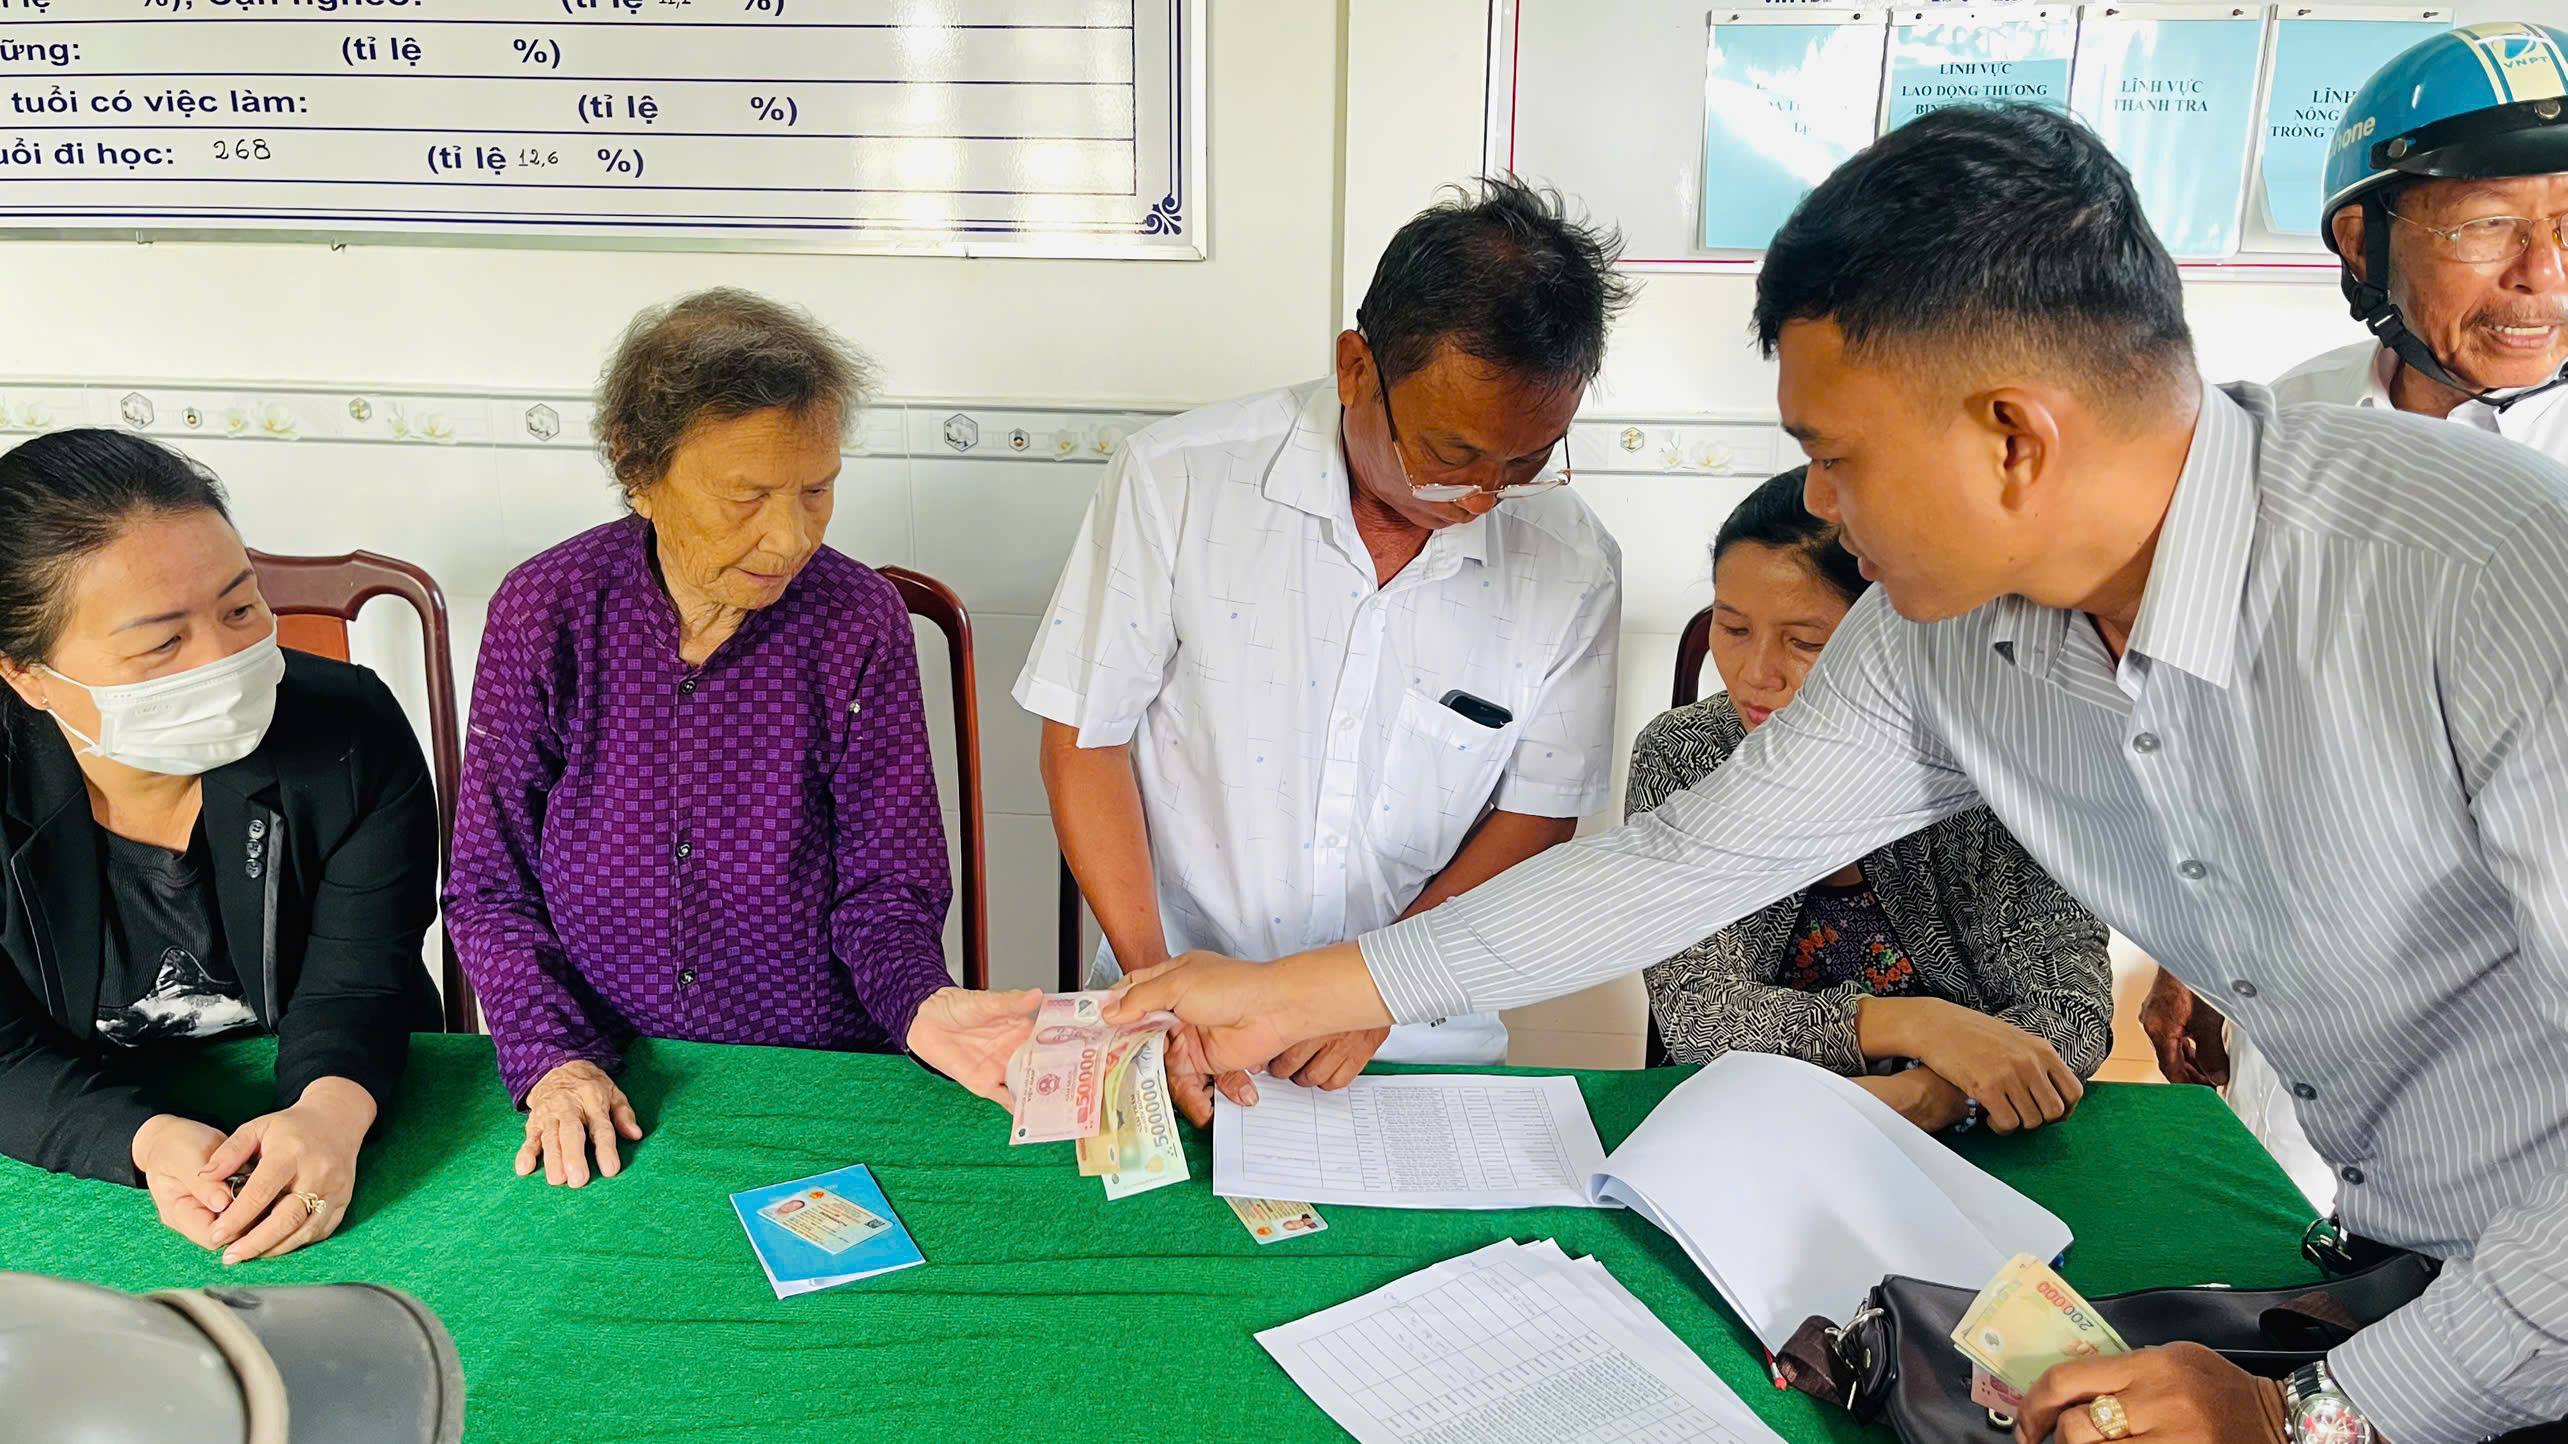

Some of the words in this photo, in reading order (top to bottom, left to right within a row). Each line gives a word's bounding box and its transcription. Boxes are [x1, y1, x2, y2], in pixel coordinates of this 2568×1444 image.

[342, 36, 377, 67] (tỉ
[390, 37, 422, 67] lệ
[513, 38, 561, 70] %)
[2504, 56, 2548, 68] VNPT
[1902, 85, 1932, 96] LAO
[2121, 77, 2162, 92] LĨNH
[2168, 78, 2204, 95] VỰC
[10, 85, 78, 113] tuổi
[90, 89, 133, 113] có
[143, 89, 218, 118] việc
[230, 89, 307, 113] làm:
[578, 94, 613, 124] (tỉ
[627, 95, 659, 125] lệ
[750, 96, 798, 127] %)
[2175, 99, 2208, 111] TRA
[213, 138, 271, 160] 268
[518, 148, 559, 168] 12,6
[54, 142, 85, 165] đi
[97, 142, 174, 170] học:
[427, 145, 462, 175] (tỉ
[475, 146, 507, 176] lệ
[597, 148, 644, 179] %)
[1141, 1079, 1169, 1148] 500000
[2036, 1280, 2095, 1332] 200000
